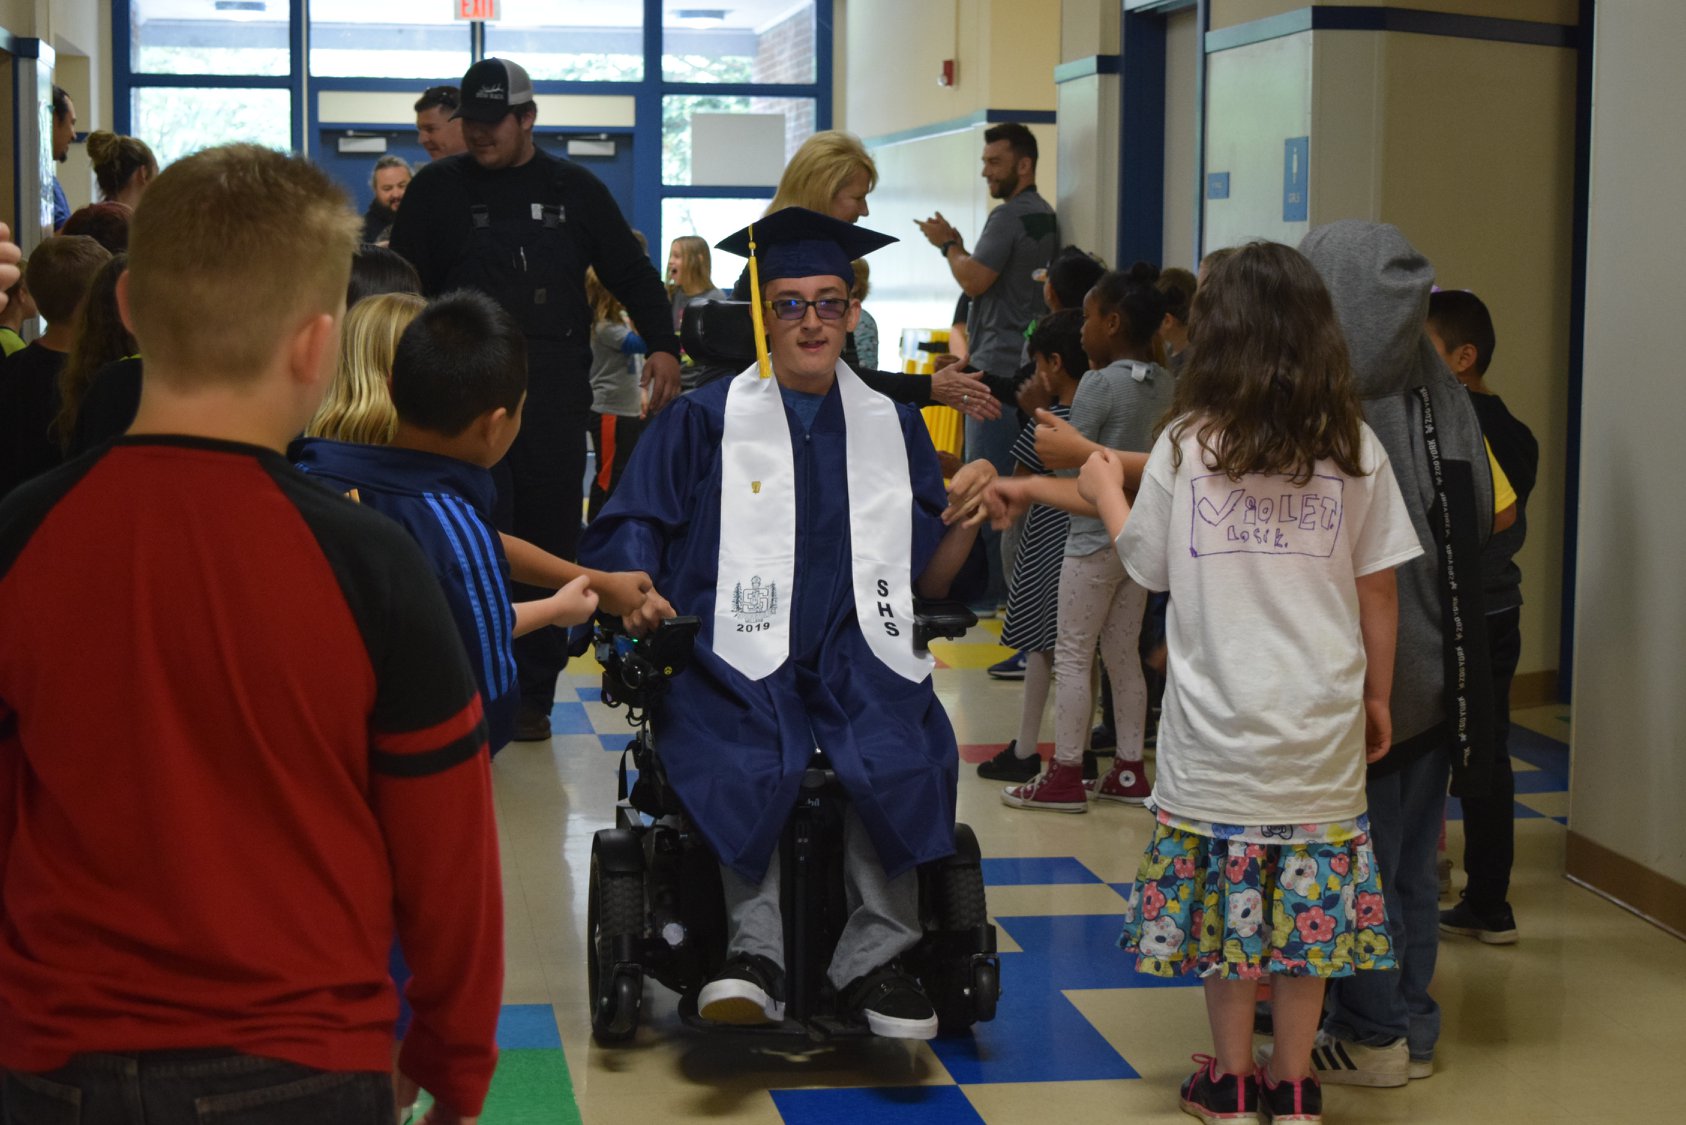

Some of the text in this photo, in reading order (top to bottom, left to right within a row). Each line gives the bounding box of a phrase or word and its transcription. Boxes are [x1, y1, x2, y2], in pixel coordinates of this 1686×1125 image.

[461, 0, 495, 18] EXIT
[1427, 439, 1442, 475] ZOO YORK
[736, 622, 771, 633] 2019
